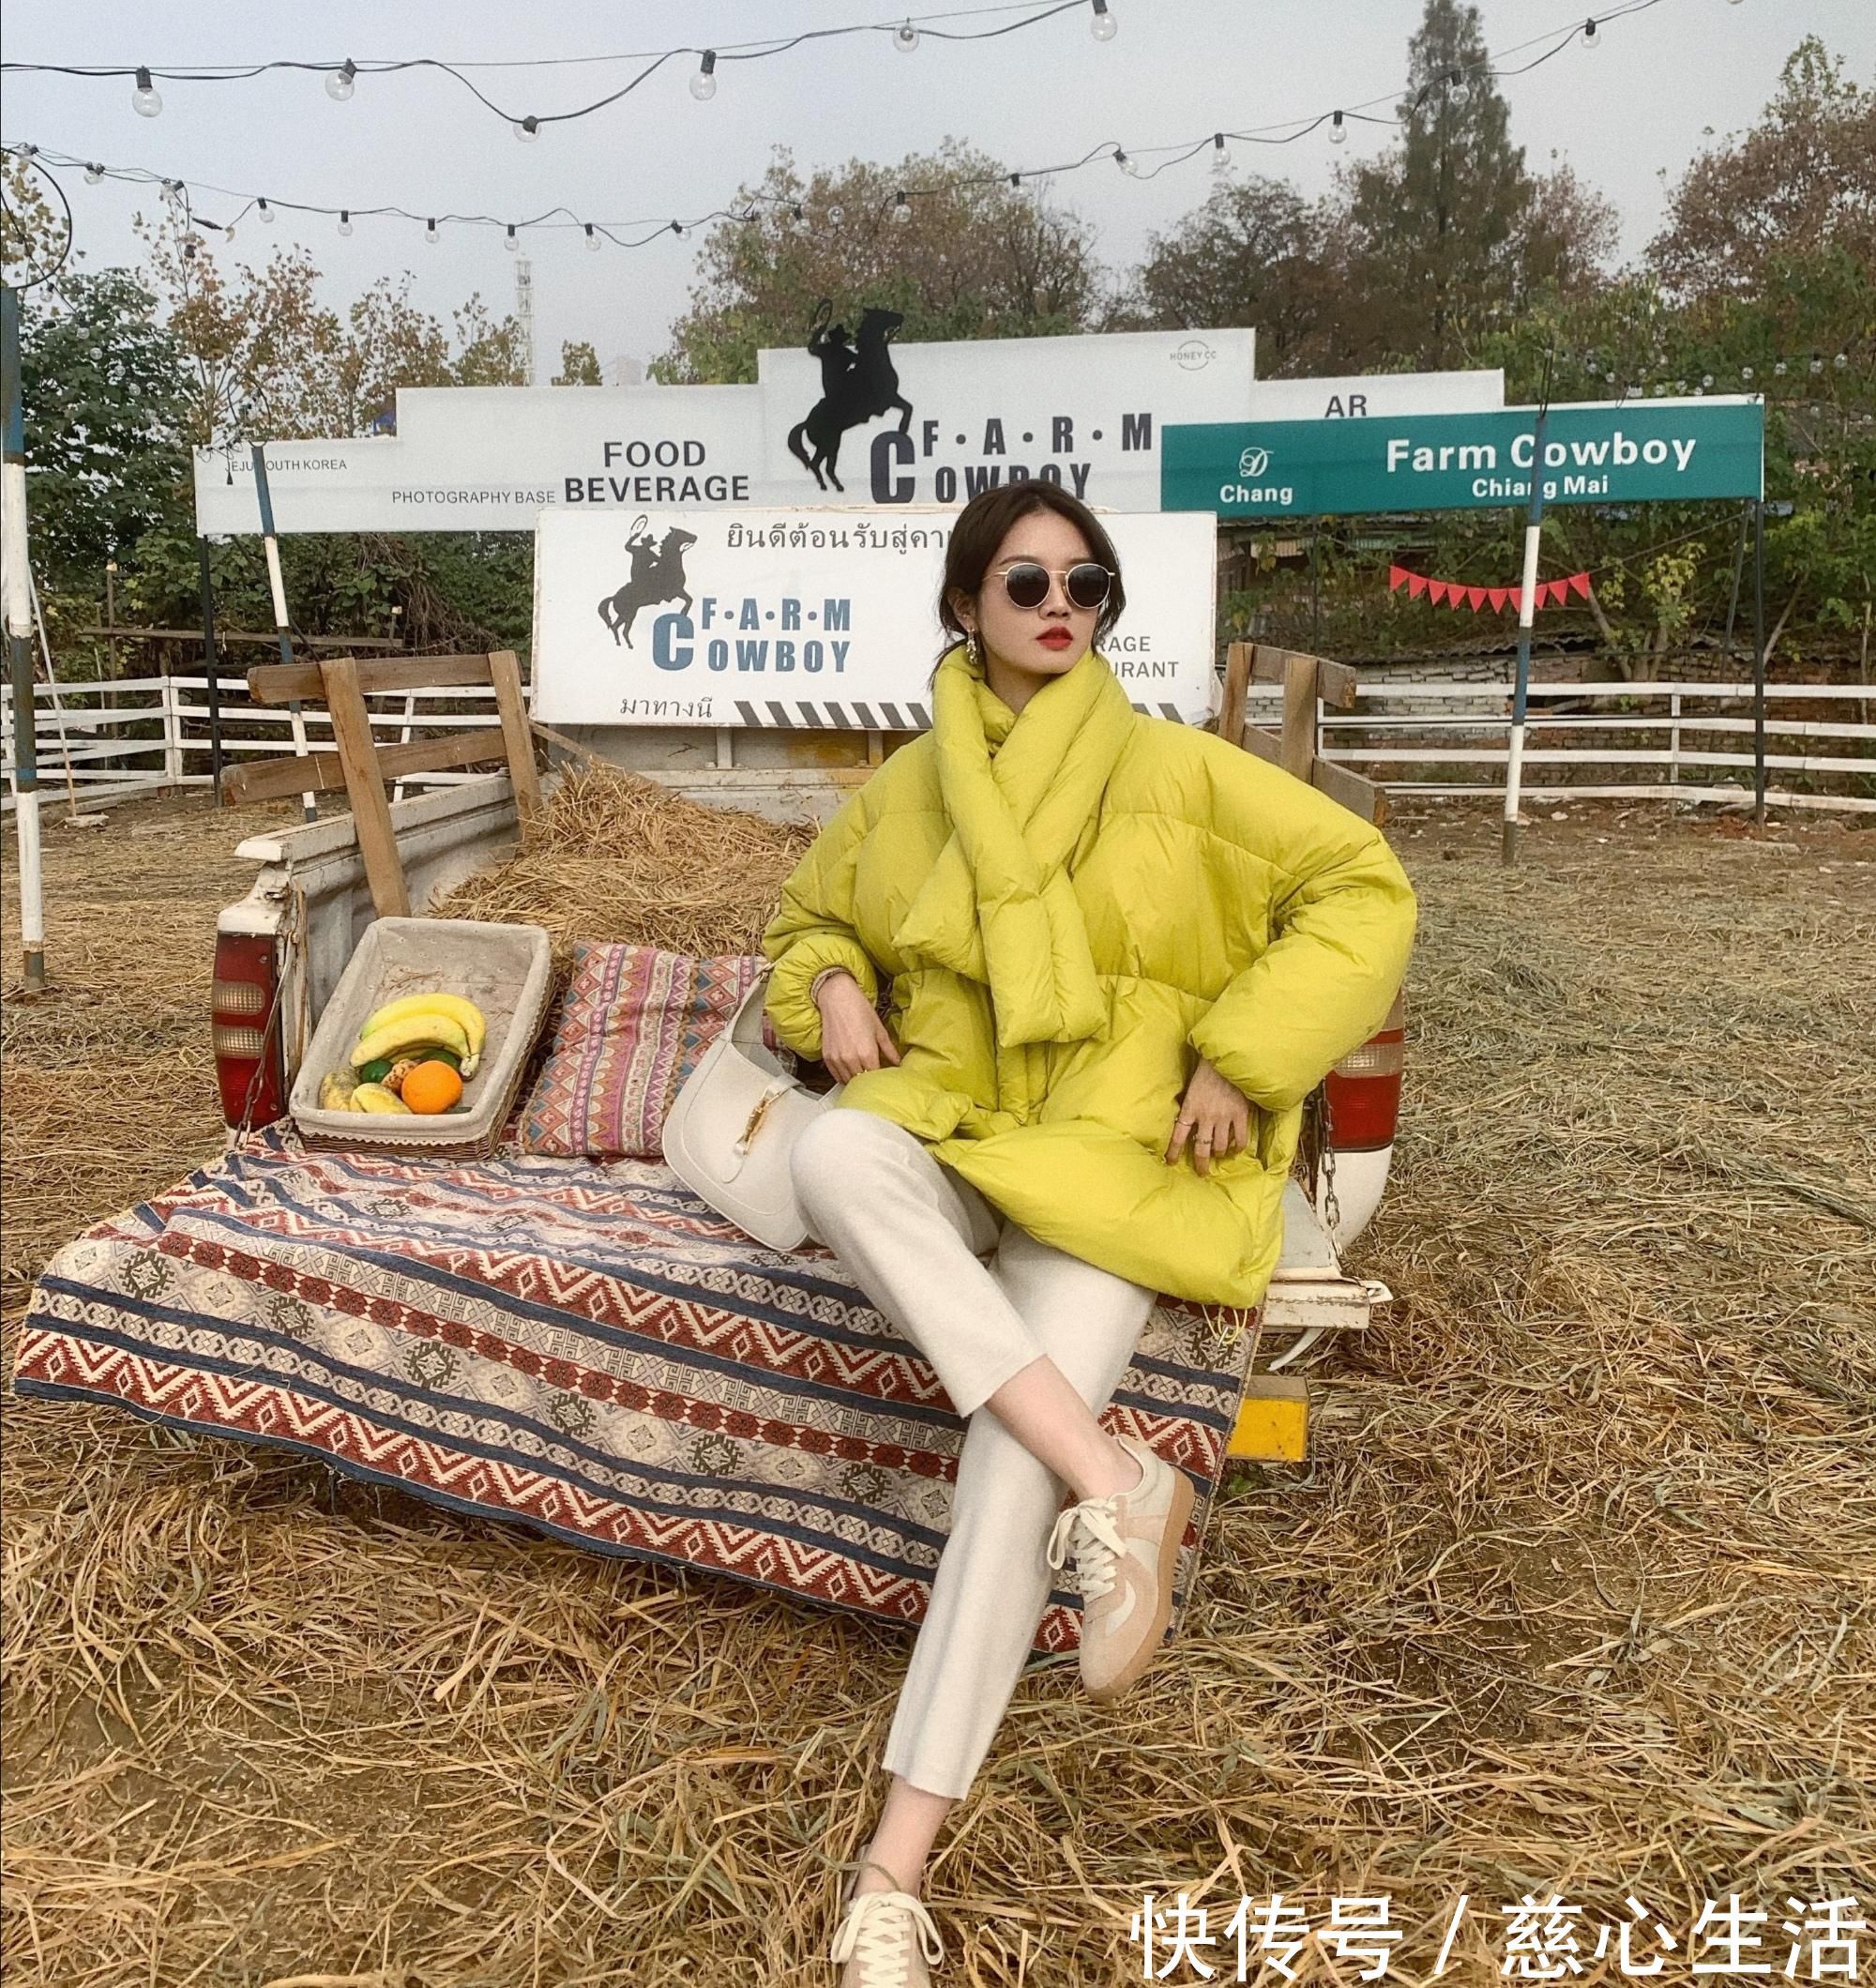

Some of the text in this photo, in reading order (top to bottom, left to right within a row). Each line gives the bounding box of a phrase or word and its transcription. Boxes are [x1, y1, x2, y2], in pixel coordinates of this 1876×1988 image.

[1324, 395, 1368, 418] AR
[603, 440, 706, 468] FOOD
[1386, 432, 1696, 473] Farm Cowboy
[265, 460, 300, 471] OUTH
[303, 459, 347, 471] KOREA
[565, 475, 749, 504] BEVERAGE
[1220, 484, 1293, 506] Chang
[1564, 475, 1609, 495] Mai
[392, 491, 556, 505] PHOTOGRAPHY BASE
[1098, 636, 1151, 652] RAGE
